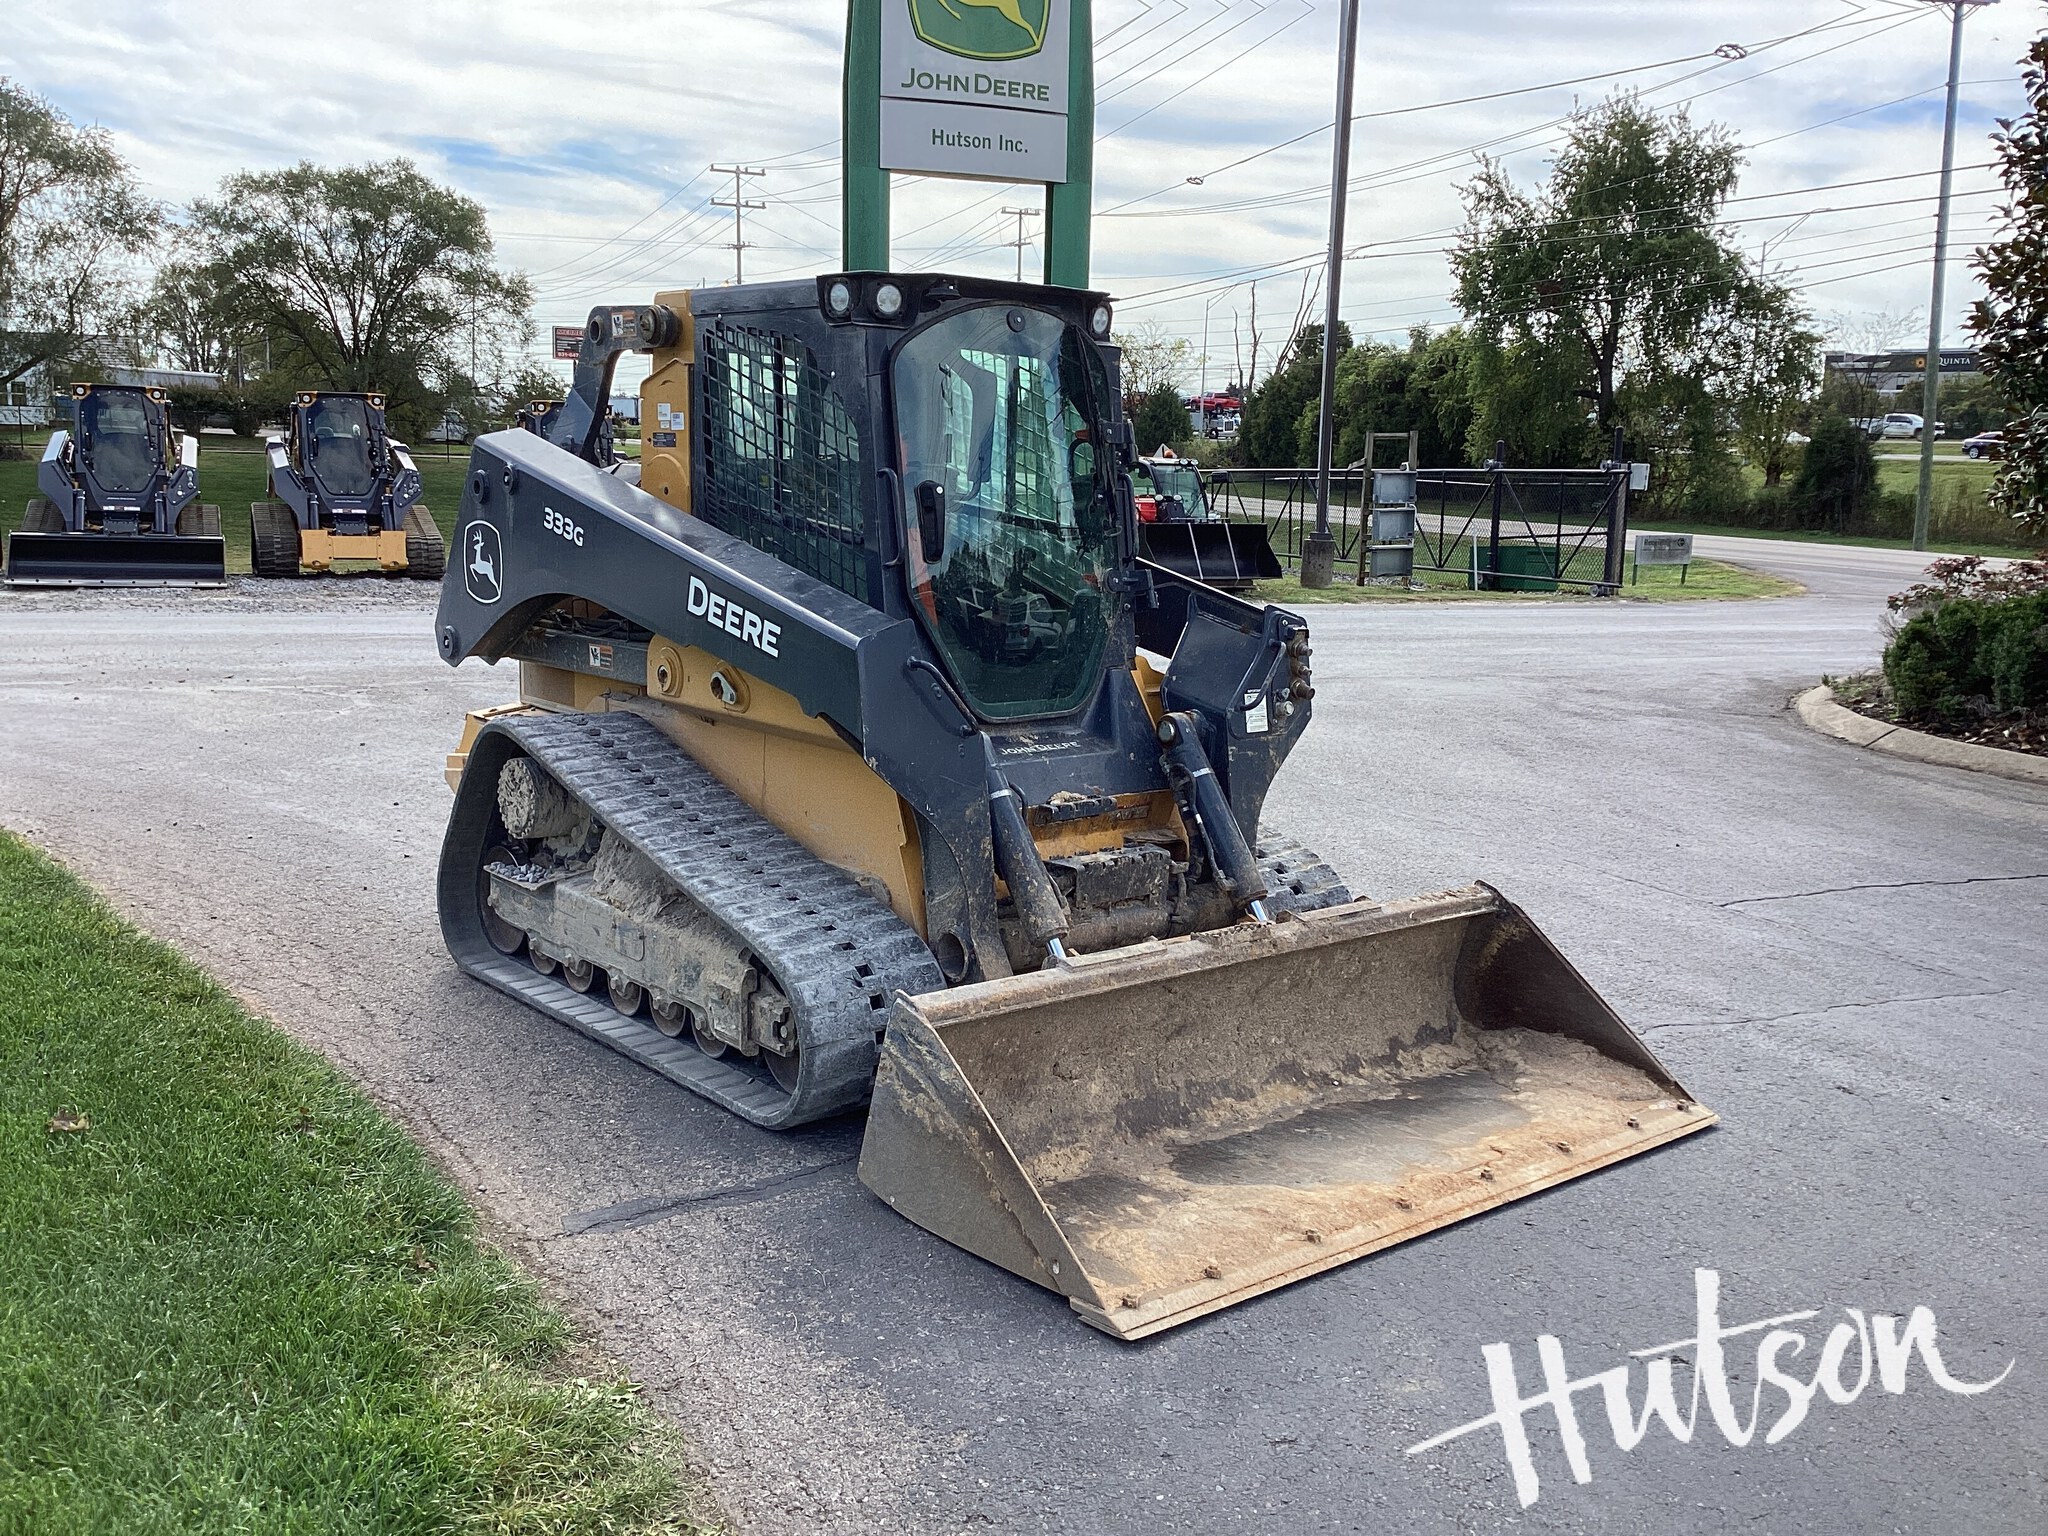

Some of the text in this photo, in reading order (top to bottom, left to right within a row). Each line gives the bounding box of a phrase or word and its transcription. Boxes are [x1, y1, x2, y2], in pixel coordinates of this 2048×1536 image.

[901, 67, 1050, 102] JOHN DEERE
[931, 128, 1029, 153] Hutson Inc.
[543, 507, 584, 547] 333G
[687, 575, 782, 658] DEERE
